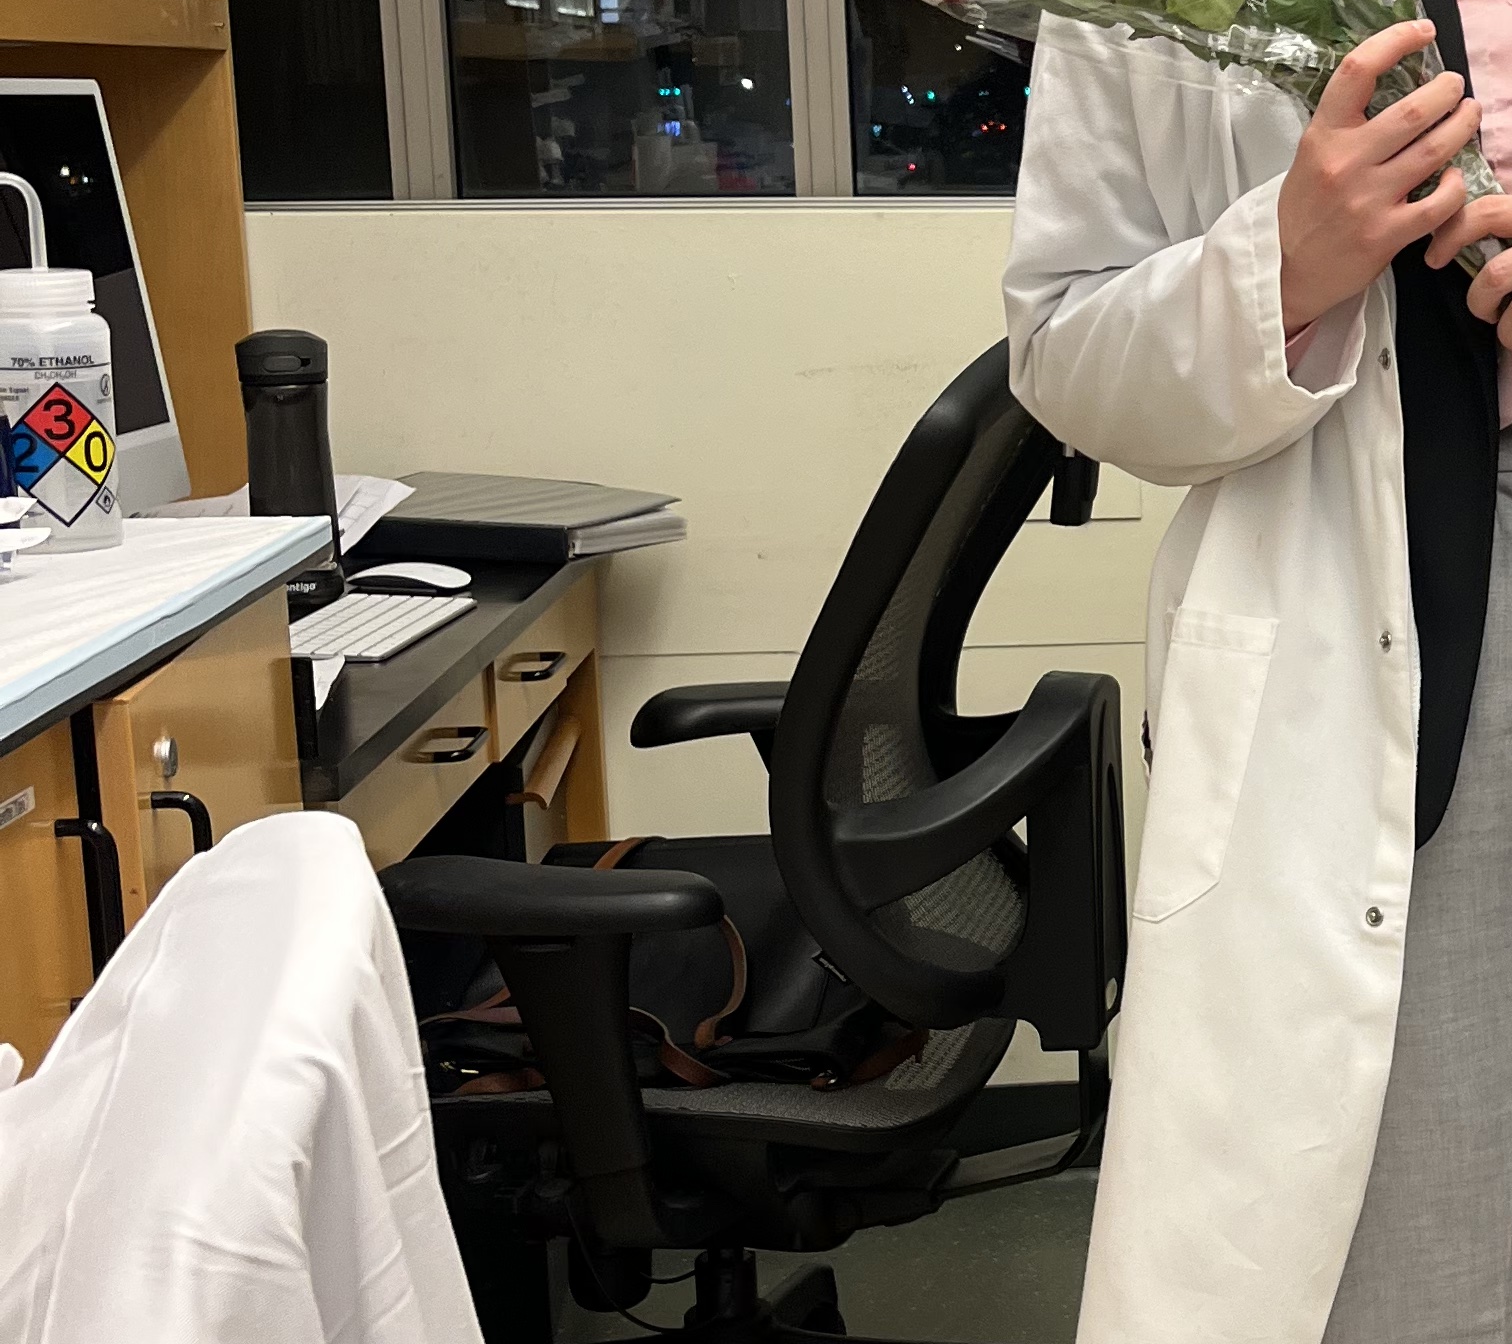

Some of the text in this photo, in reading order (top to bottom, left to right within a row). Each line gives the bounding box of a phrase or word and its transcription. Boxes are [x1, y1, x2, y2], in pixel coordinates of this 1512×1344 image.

[10, 355, 95, 368] 70% ETHANOL
[42, 398, 76, 441] 3
[12, 430, 108, 473] 2 0
